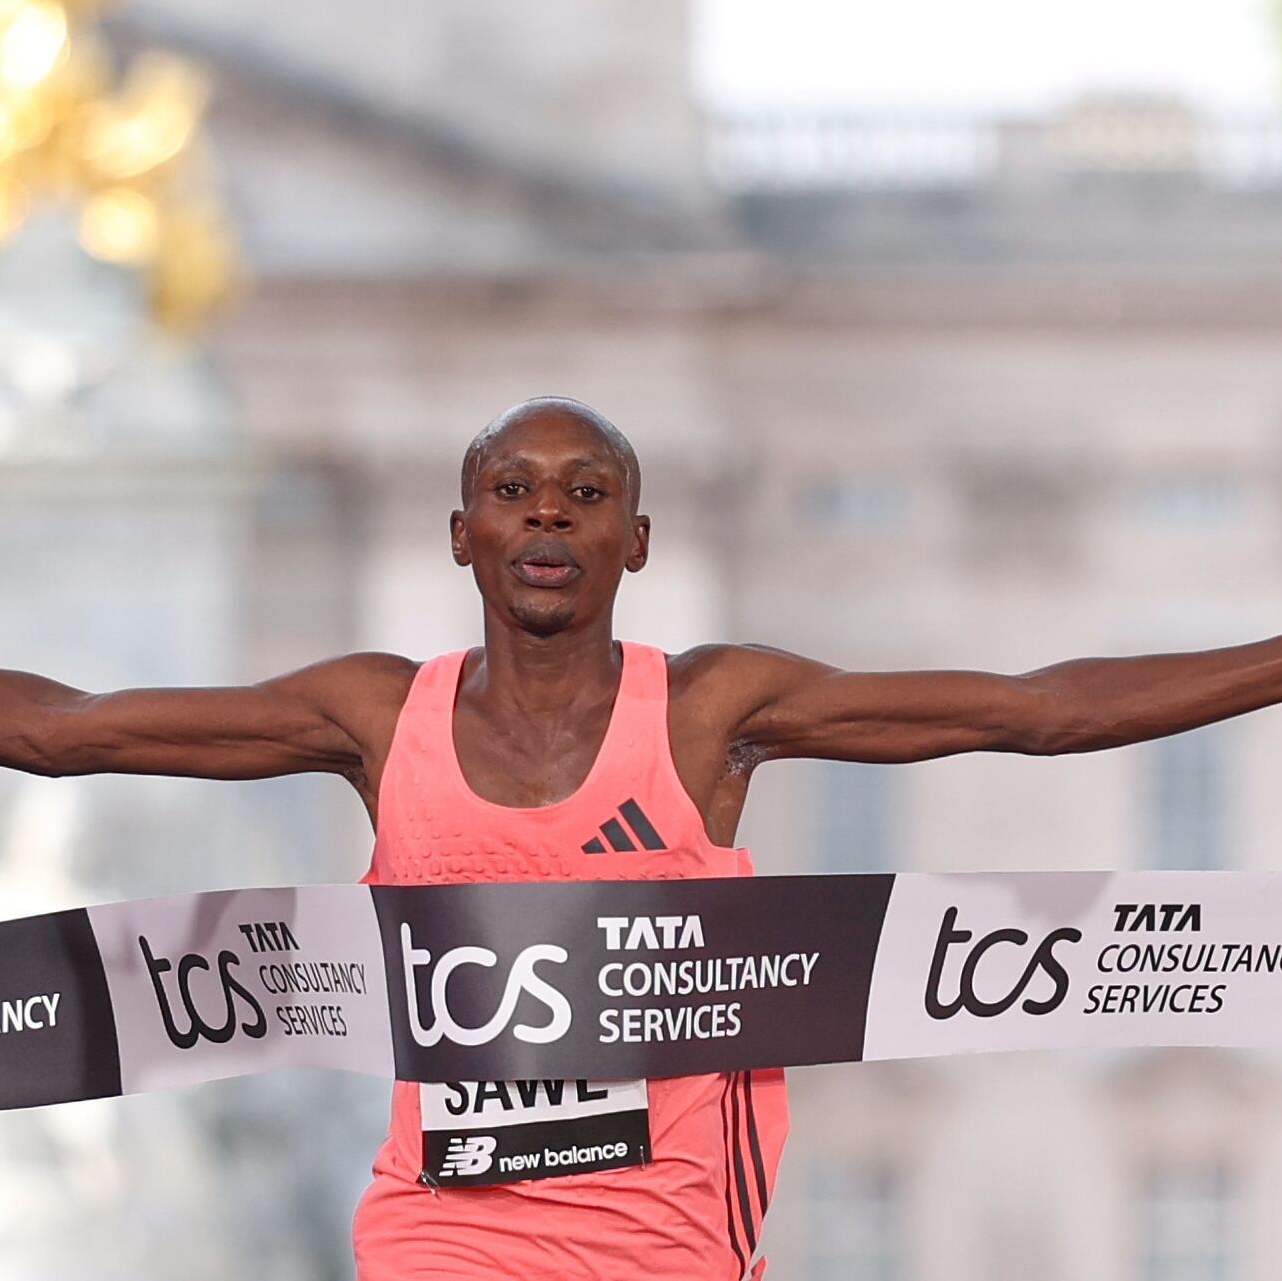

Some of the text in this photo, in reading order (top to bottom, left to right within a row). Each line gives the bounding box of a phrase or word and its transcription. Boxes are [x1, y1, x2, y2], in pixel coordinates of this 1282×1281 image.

[598, 915, 705, 950] TATA
[1114, 903, 1201, 932] TATA
[238, 922, 300, 953] TATA
[259, 962, 368, 995] CONSULTANCY
[599, 953, 819, 997] CONSULTANCY
[925, 907, 1083, 1020] tcs
[139, 935, 267, 1050] tcs
[401, 922, 572, 1047] tcs
[1083, 984, 1227, 1015] SERVICES
[276, 1006, 347, 1037] SERVICES
[599, 1003, 741, 1043] SERVICES
[499, 1153, 540, 1172] new
[544, 1142, 628, 1167] balance
